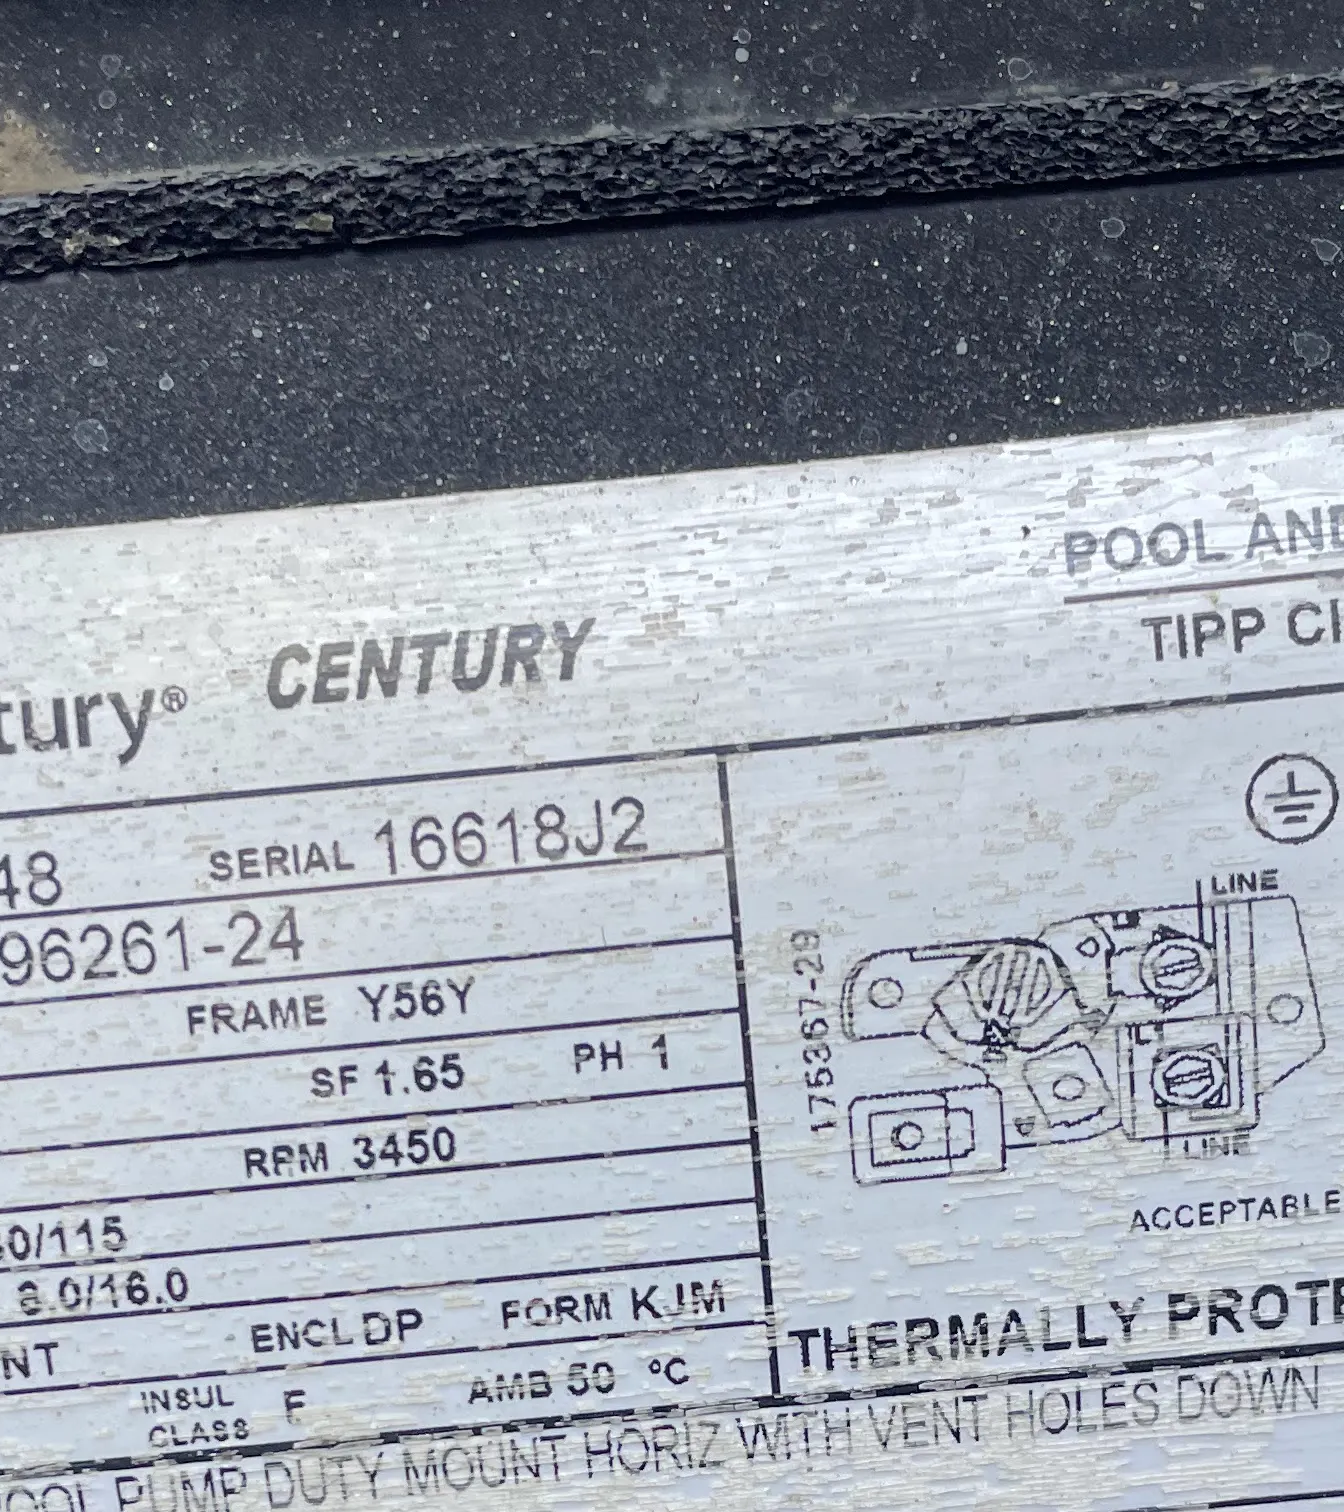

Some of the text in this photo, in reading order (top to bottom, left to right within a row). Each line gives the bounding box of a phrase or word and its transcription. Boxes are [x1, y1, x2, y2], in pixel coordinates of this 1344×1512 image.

[1062, 514, 1229, 576] POOL
[265, 617, 598, 711] CENTURY
[1140, 606, 1268, 663] TIPP
[208, 839, 356, 882] SERIAL
[373, 795, 650, 877] 16618J2
[1210, 867, 1280, 896] LINE
[186, 994, 327, 1036] FRAME
[310, 1064, 359, 1099] SF
[374, 1052, 466, 1096] 1.65
[572, 1040, 623, 1075] PH
[651, 1033, 670, 1072] 1
[243, 1141, 330, 1179] RPM
[352, 1125, 458, 1171] 3450
[1128, 1189, 1342, 1235] ACCEPTABLE
[249, 1319, 355, 1354] ENCL
[363, 1307, 425, 1346] DP
[499, 1290, 612, 1330] FORM
[628, 1278, 727, 1321] KJM
[788, 1295, 1146, 1372] THERMALLY
[140, 1383, 236, 1414] INSUL
[147, 1418, 251, 1448] CLASS
[283, 1389, 308, 1427] F
[467, 1370, 553, 1404] AMB
[565, 1362, 616, 1397] 50
[264, 1450, 383, 1511] DUTY
[403, 1433, 567, 1498] MOUNT
[585, 1418, 721, 1479] HORIZ
[734, 1408, 853, 1463] WITH
[866, 1395, 989, 1454] VENT
[1006, 1378, 1160, 1438] HOLES
[1178, 1365, 1320, 1422] DOWN
